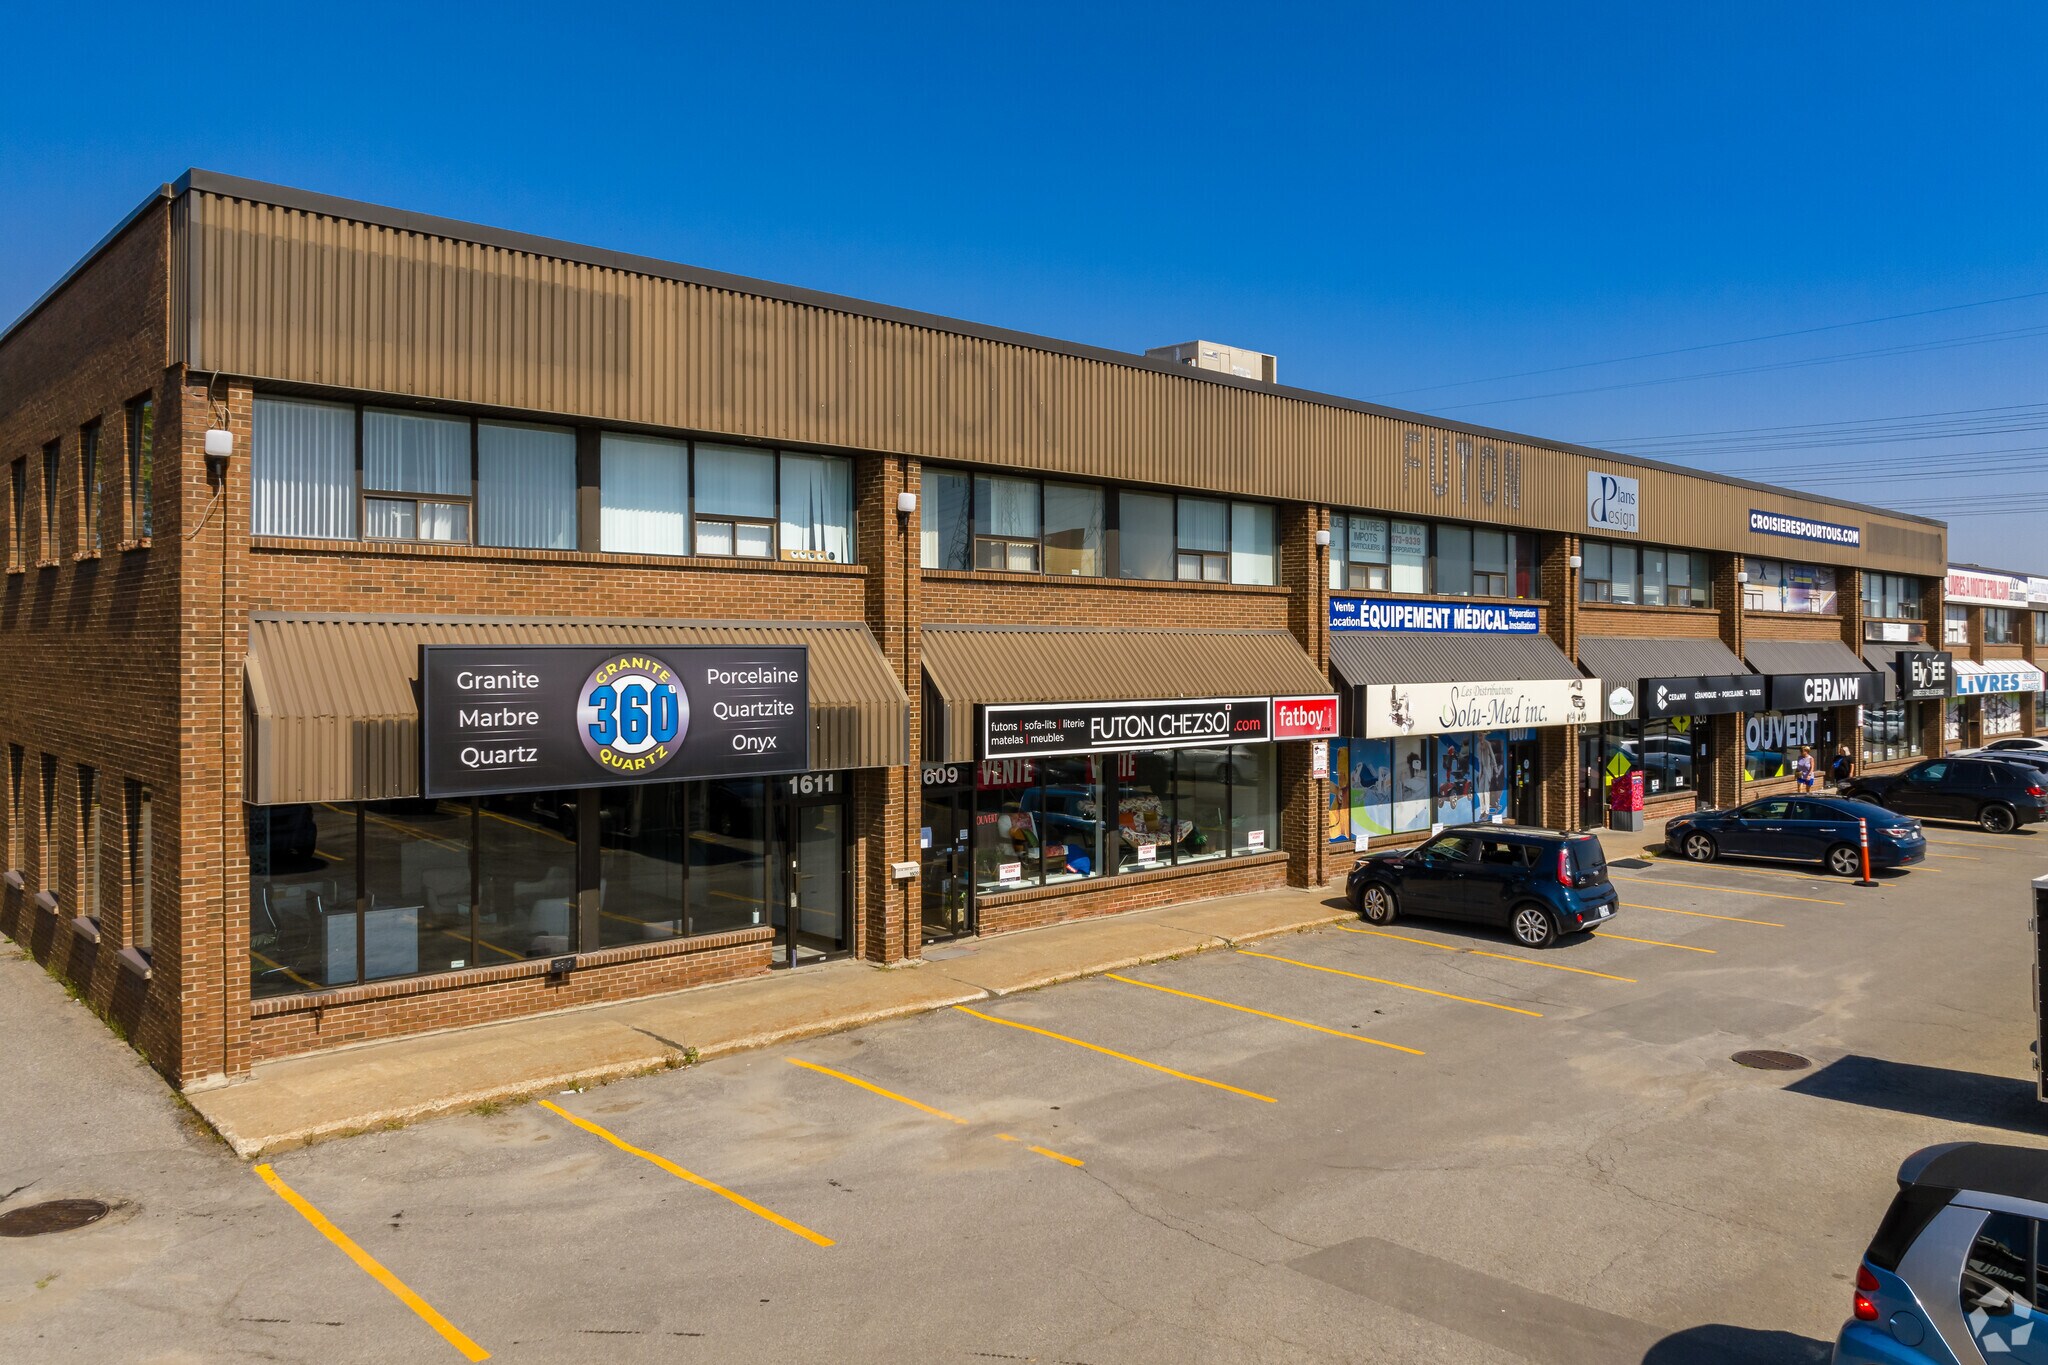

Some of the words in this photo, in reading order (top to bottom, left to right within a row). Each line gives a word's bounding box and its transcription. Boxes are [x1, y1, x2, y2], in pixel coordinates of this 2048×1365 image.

[1404, 431, 1520, 511] FUTON
[1600, 475, 1636, 506] Plans
[1360, 520, 1385, 532] LIVRES
[1750, 513, 1859, 544] CROISIERESPOURTOUS.COM
[1334, 601, 1354, 613] Vente
[1360, 600, 1450, 629] ÉQUIPEMENT
[1453, 604, 1509, 631] MÉDICAL
[1329, 615, 1360, 627] Location
[456, 670, 539, 690] Granite
[595, 657, 672, 684] GRANITE
[706, 667, 799, 685] Porcelaine
[1460, 685, 1472, 697] Les
[1474, 683, 1514, 697] Distributions
[458, 707, 539, 728] Marbre
[712, 699, 795, 721] Quartzite
[1439, 686, 1524, 728] Solu-Med
[1525, 698, 1548, 723] inc.
[991, 720, 1018, 732] futons
[1024, 719, 1057, 731] sofa-lits
[1062, 718, 1085, 729] literie
[1090, 714, 1155, 740] FUTON
[1233, 717, 1261, 732] .com
[1279, 705, 1324, 731] fatboy
[991, 734, 1024, 746] matelas
[1030, 732, 1065, 744] meubles
[1745, 712, 1818, 751] OUVERT
[732, 734, 777, 754] Onyx
[460, 745, 538, 768] Quartz
[599, 743, 669, 771] QUARTZ
[789, 773, 834, 795] 1611
[976, 813, 998, 826] OUVERT
